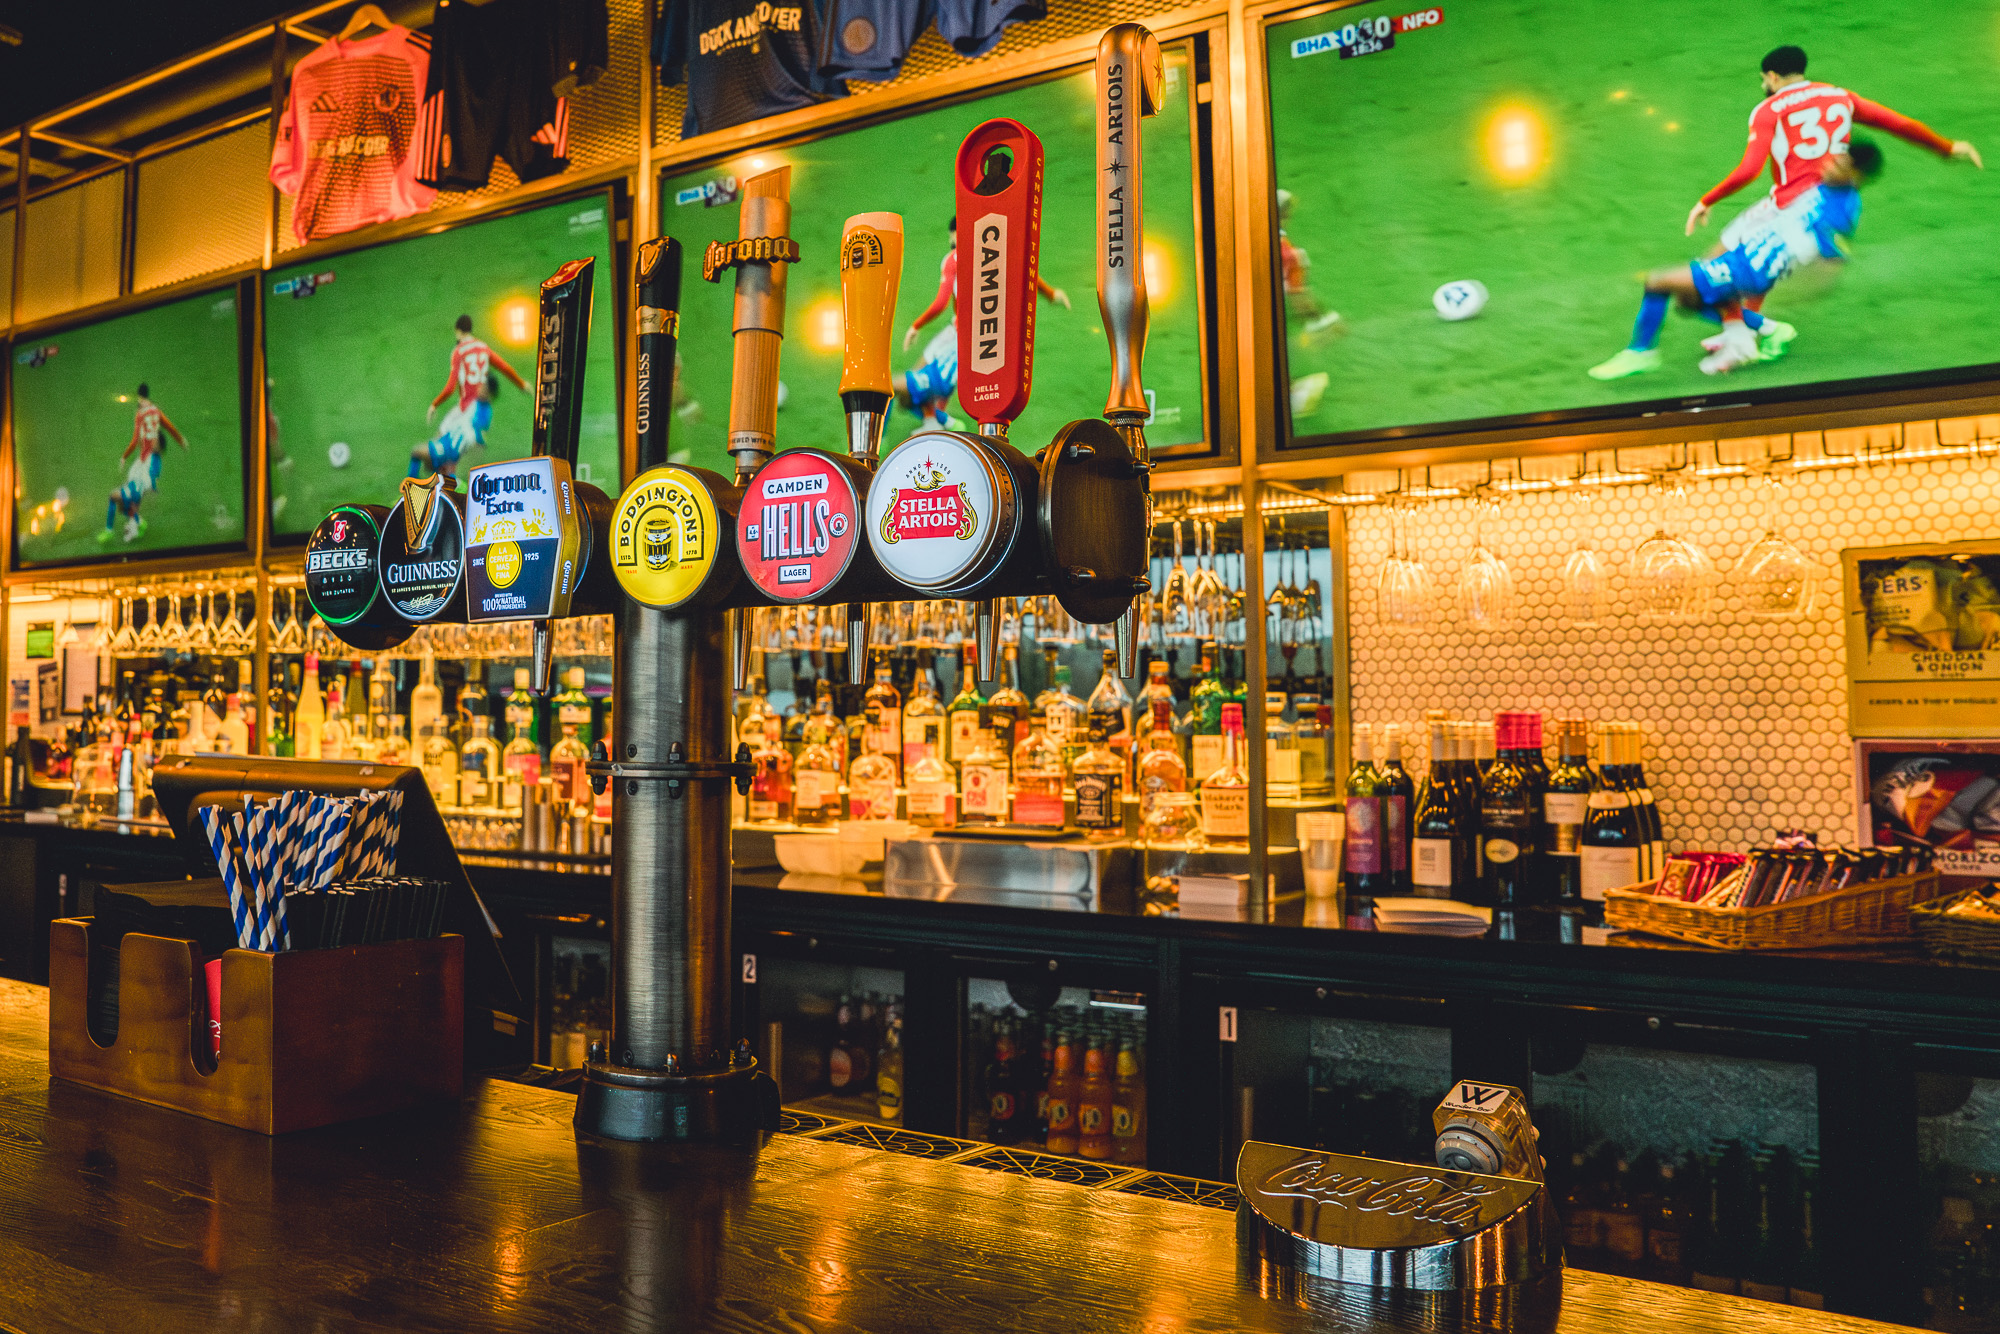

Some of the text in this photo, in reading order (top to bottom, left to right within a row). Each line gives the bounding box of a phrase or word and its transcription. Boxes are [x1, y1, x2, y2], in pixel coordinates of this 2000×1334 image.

[1297, 9, 1440, 54] BHA 0 0 NFO
[1792, 102, 1851, 161] 32
[1107, 63, 1124, 268] STELLA ARTOIS
[1032, 158, 1042, 231] CAMDEN
[979, 225, 1000, 361] CAMDEN
[1023, 302, 1033, 392] BREWERY
[636, 353, 650, 435] GUINNESS
[974, 392, 1000, 402] LAGER
[975, 384, 999, 394] HELLS
[471, 472, 542, 503] Corona
[767, 479, 823, 494] CAMDEN
[484, 497, 524, 516] Extra
[561, 481, 571, 515] Corona
[899, 497, 957, 513] STELLA
[620, 487, 697, 546] BODDINGTONS
[898, 512, 957, 529] ARTOIS
[761, 499, 830, 561] HELLS
[309, 549, 367, 570] BECK'S
[472, 552, 539, 566] SINCE 1925
[489, 554, 518, 563] CERVEZA
[496, 563, 510, 571] MAS
[387, 560, 458, 583] GUINNESS
[495, 571, 511, 580] FINA
[562, 560, 572, 595] Corona
[783, 569, 807, 577] LAGER
[1912, 652, 1986, 662] CHEDDAR
[1928, 663, 1983, 671] ONION
[745, 957, 755, 979] 2
[1224, 1010, 1233, 1038] 1
[1255, 1160, 1506, 1227] Coca-Cola
